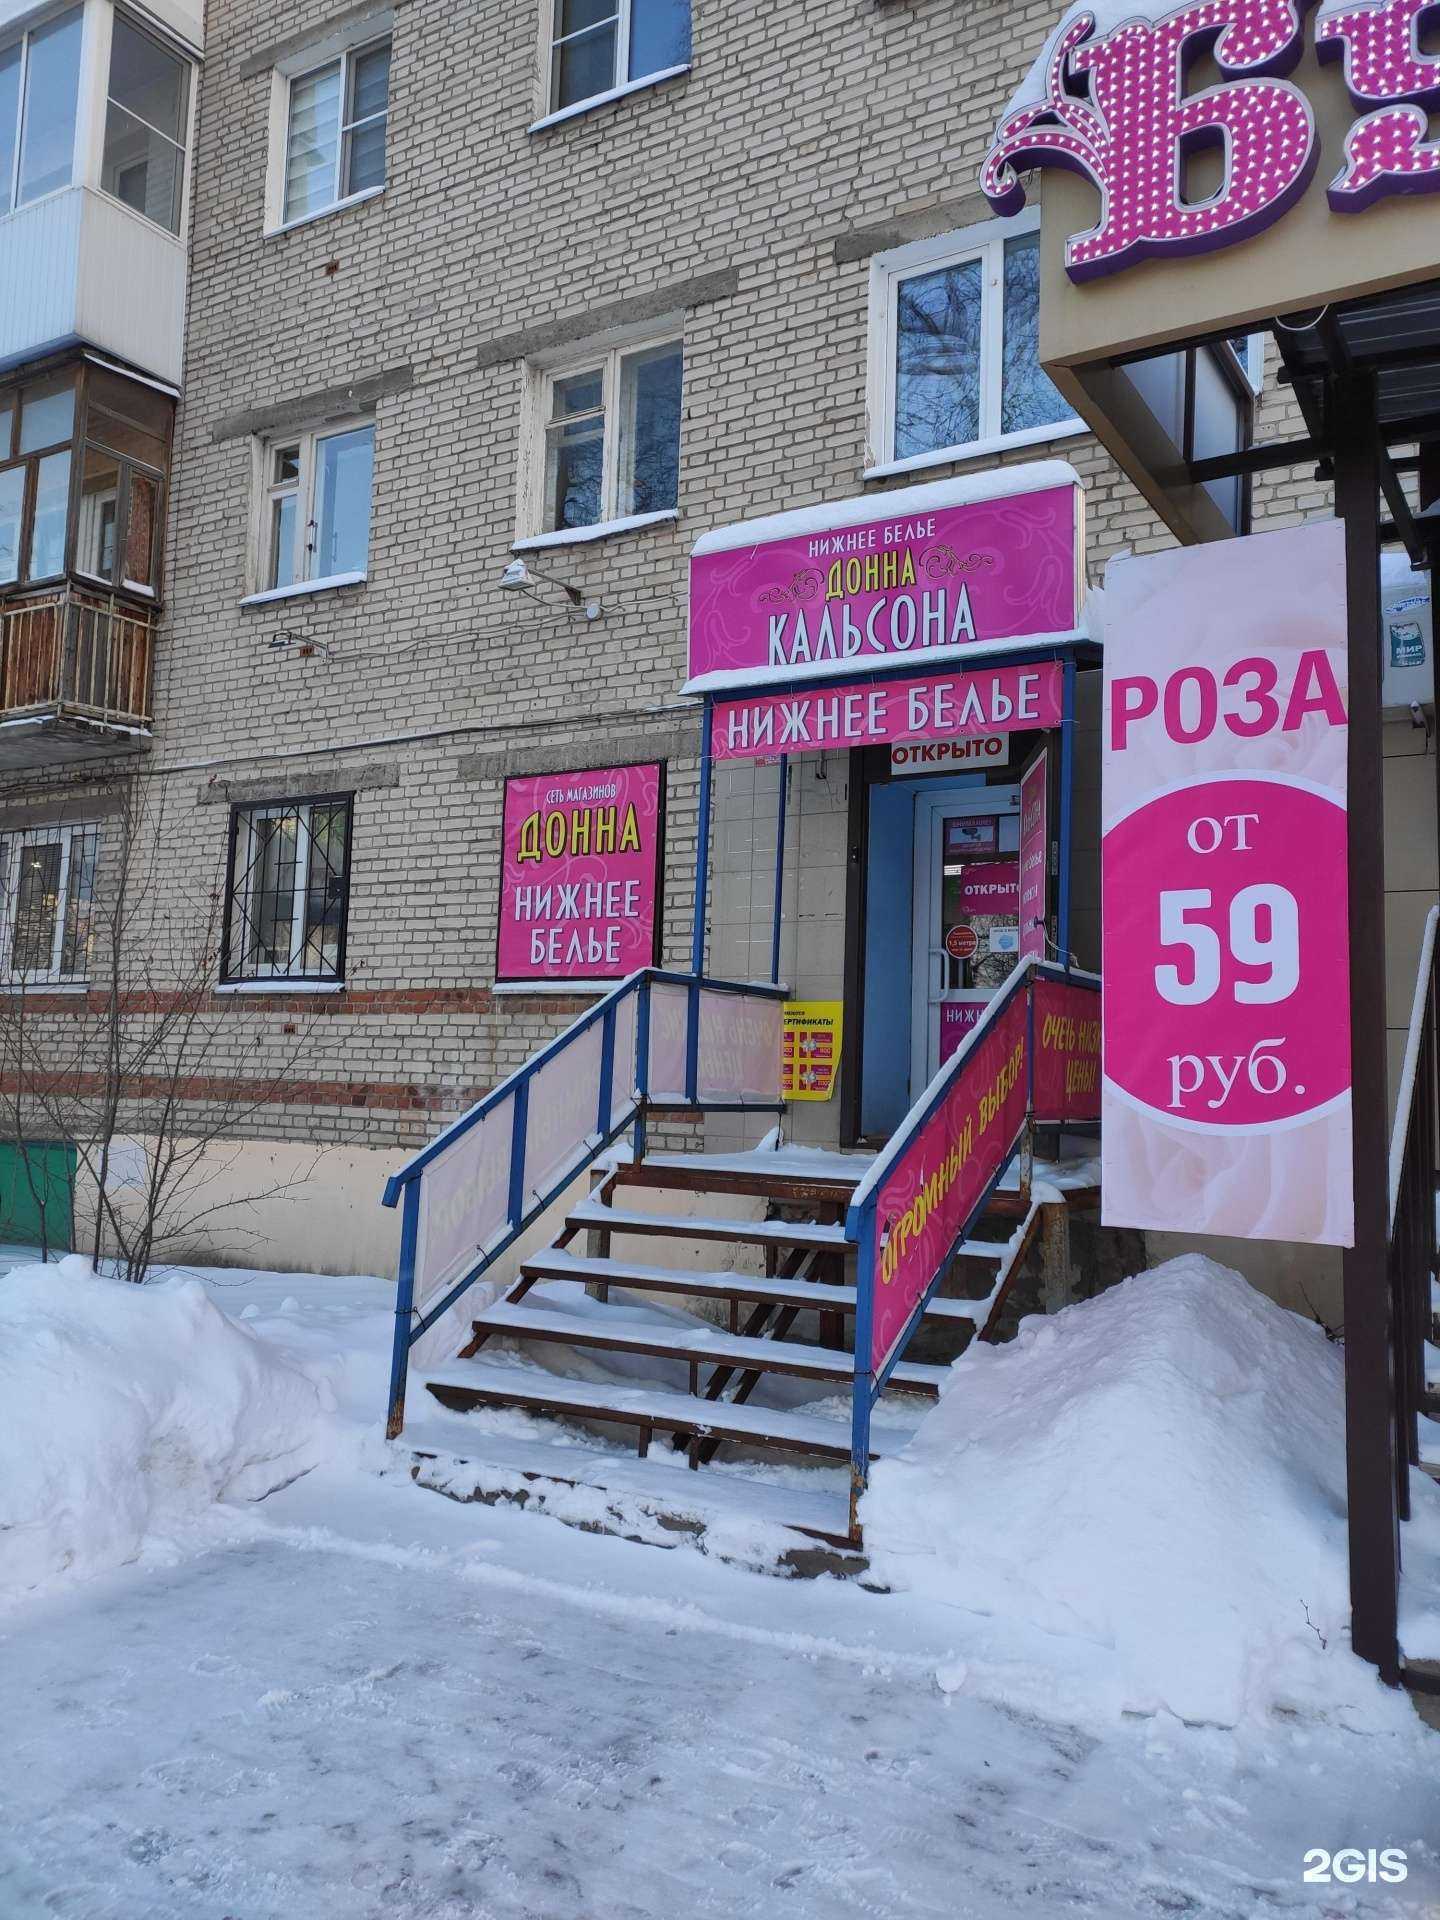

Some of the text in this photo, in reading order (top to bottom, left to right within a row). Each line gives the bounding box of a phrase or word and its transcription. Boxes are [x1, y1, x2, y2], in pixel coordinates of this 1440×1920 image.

[808, 518, 937, 558] НИЖНЕЕ БЕЛЬЕ
[825, 547, 917, 601] ДОННА
[767, 582, 977, 667] КАЛЬСОНА
[1396, 645, 1423, 655] МИР
[727, 673, 1040, 750] НИЖНЕЕ БЕЛЬЕ
[1110, 648, 1348, 752] РОЗА
[891, 737, 1003, 765] ОТКРЫТО
[546, 783, 616, 804] СЕТЬ МАГАЗИНОВ
[517, 802, 642, 864] ДОННА
[1186, 813, 1260, 855] от
[514, 879, 641, 921] НИЖНЕЕ
[529, 926, 621, 965] БЕЛЬЕ
[1153, 881, 1301, 1007] 59
[1042, 1012, 1075, 1052] ОЧЕНЬ
[1166, 1036, 1308, 1110] руб.
[881, 1036, 1025, 1286] ОГРОМНЫЙ ВЫБОР!
